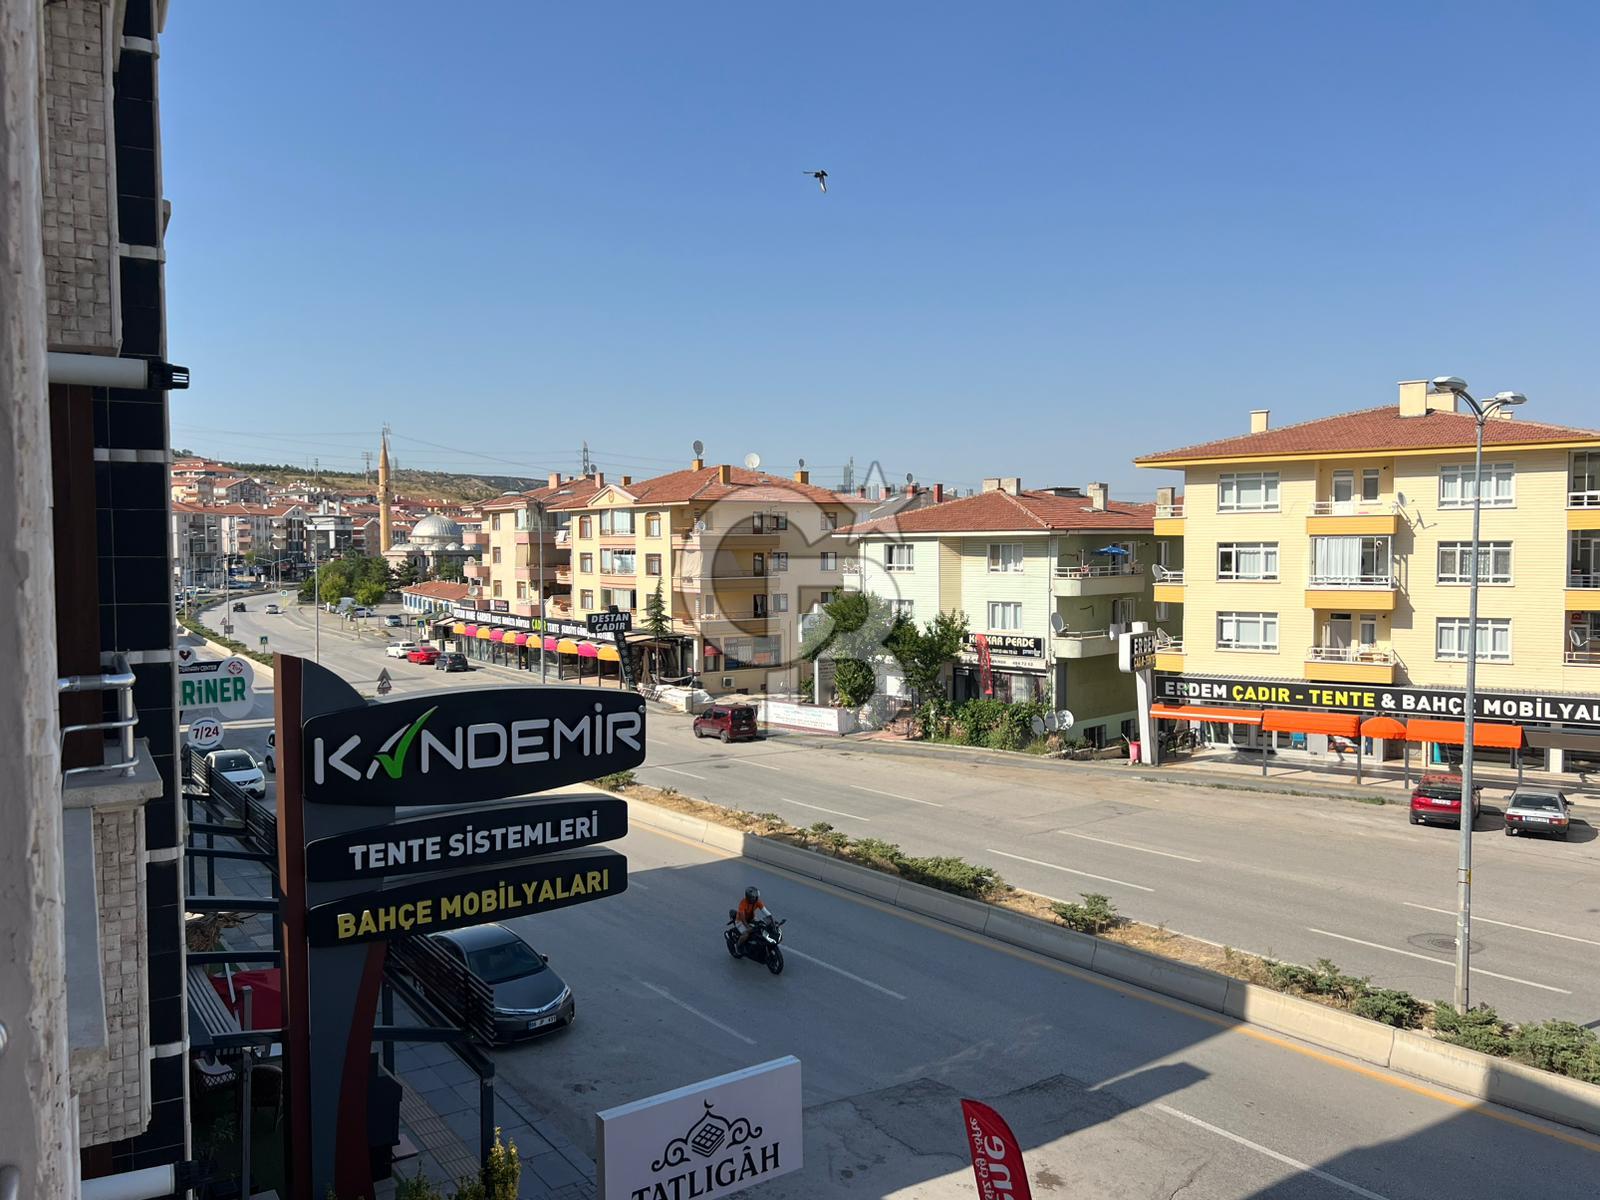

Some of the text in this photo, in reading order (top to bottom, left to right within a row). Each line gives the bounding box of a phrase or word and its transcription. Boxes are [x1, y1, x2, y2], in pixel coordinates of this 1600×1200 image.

[591, 612, 629, 624] DESTAN
[1005, 637, 1035, 648] PERDE
[1165, 681, 1227, 699] ERDEM
[1232, 685, 1290, 702] ÇADIR
[1309, 689, 1376, 708] TENTE
[1381, 693, 1396, 709] &
[1402, 694, 1477, 715] BAHÇ
[192, 725, 220, 740] 7/24
[349, 809, 599, 870] TENTE SİSTEMLERİ
[337, 868, 610, 940] BAHÇE MOBİLYALARI
